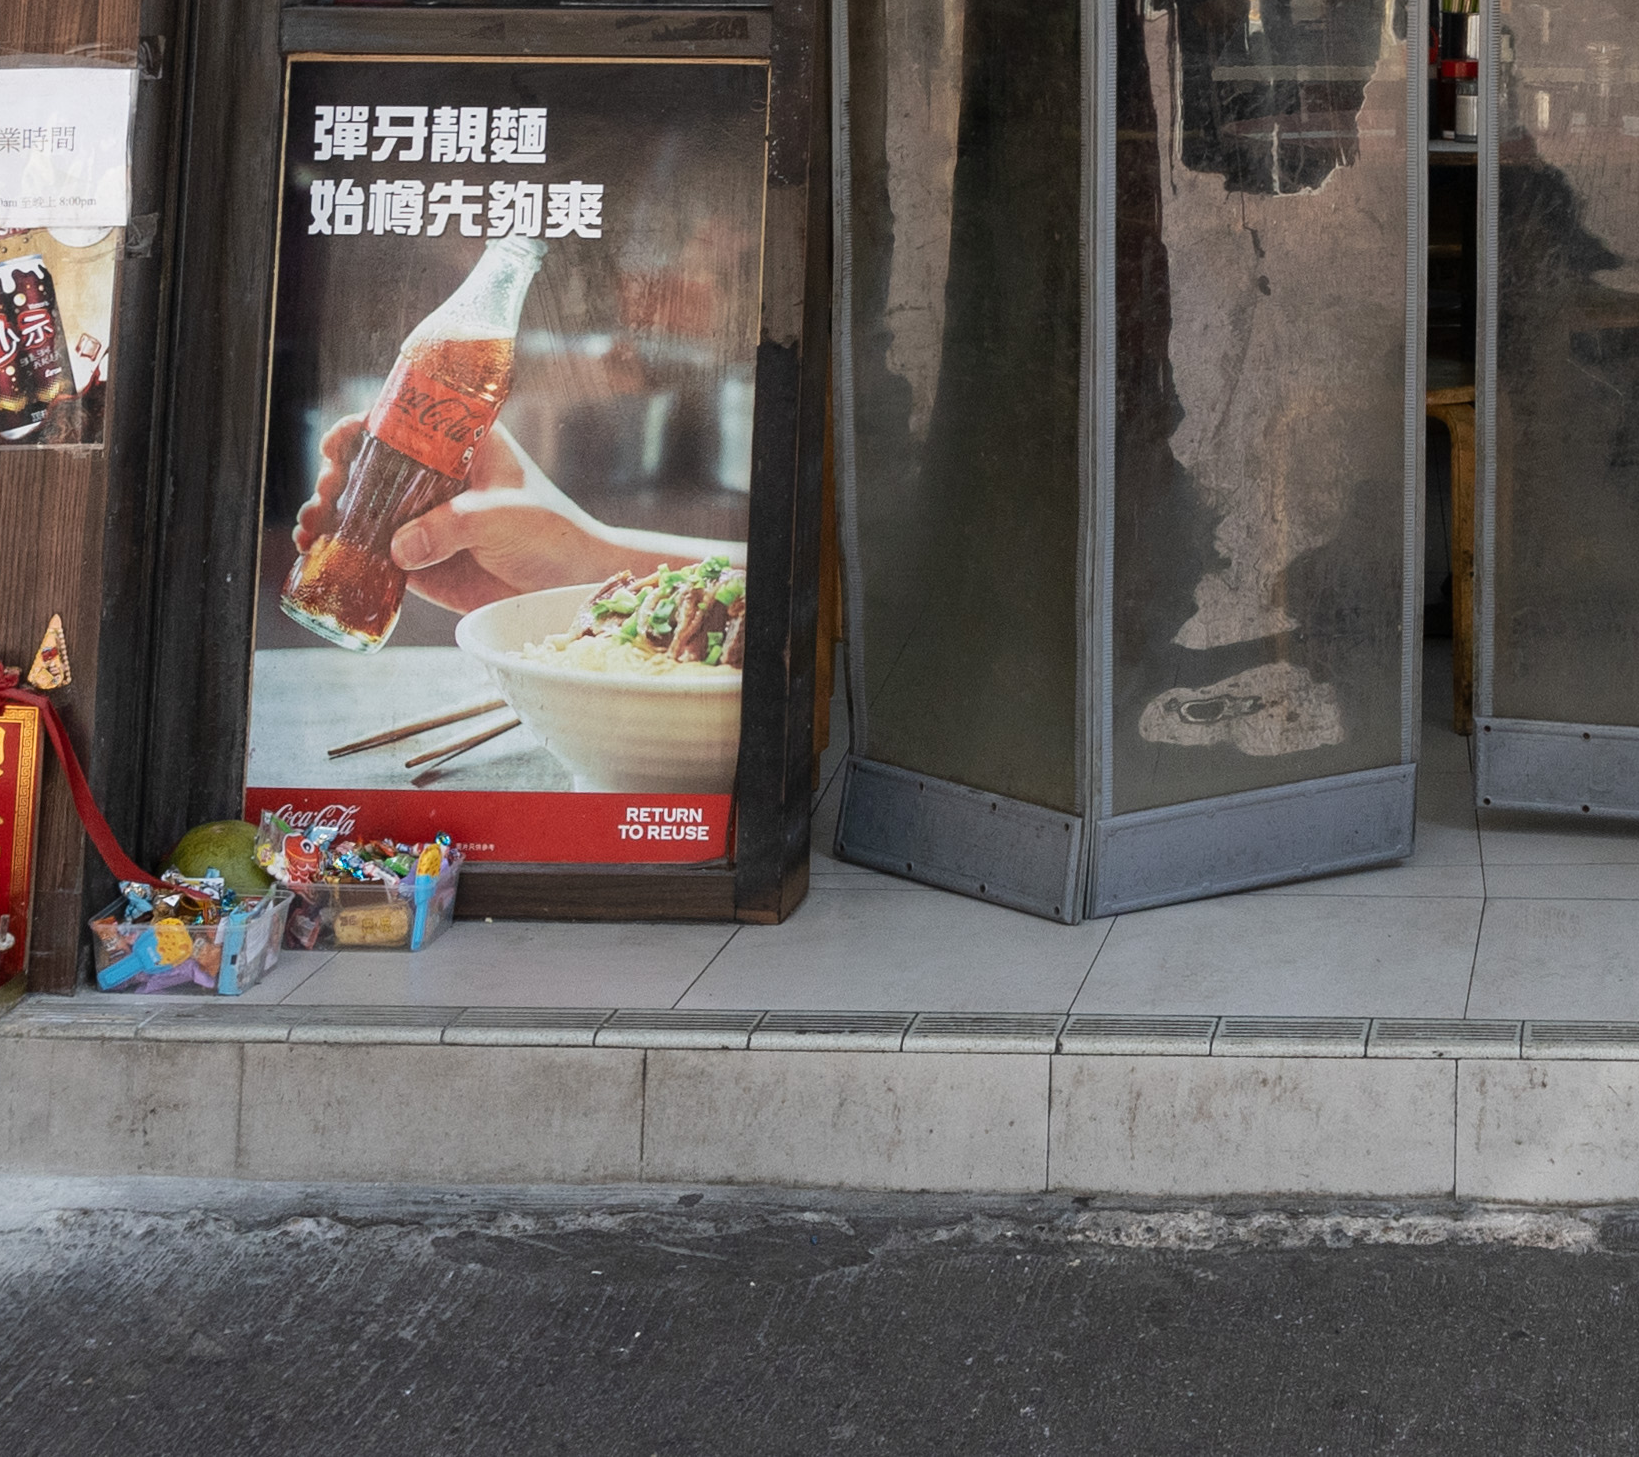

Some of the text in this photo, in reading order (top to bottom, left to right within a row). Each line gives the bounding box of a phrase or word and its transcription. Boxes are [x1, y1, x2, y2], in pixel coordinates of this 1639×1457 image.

[313, 105, 548, 164] 彈牙靚麵
[307, 179, 604, 239] 始樽先夠爽
[617, 824, 710, 842] TO REUSE
[625, 806, 703, 824] RETURN
